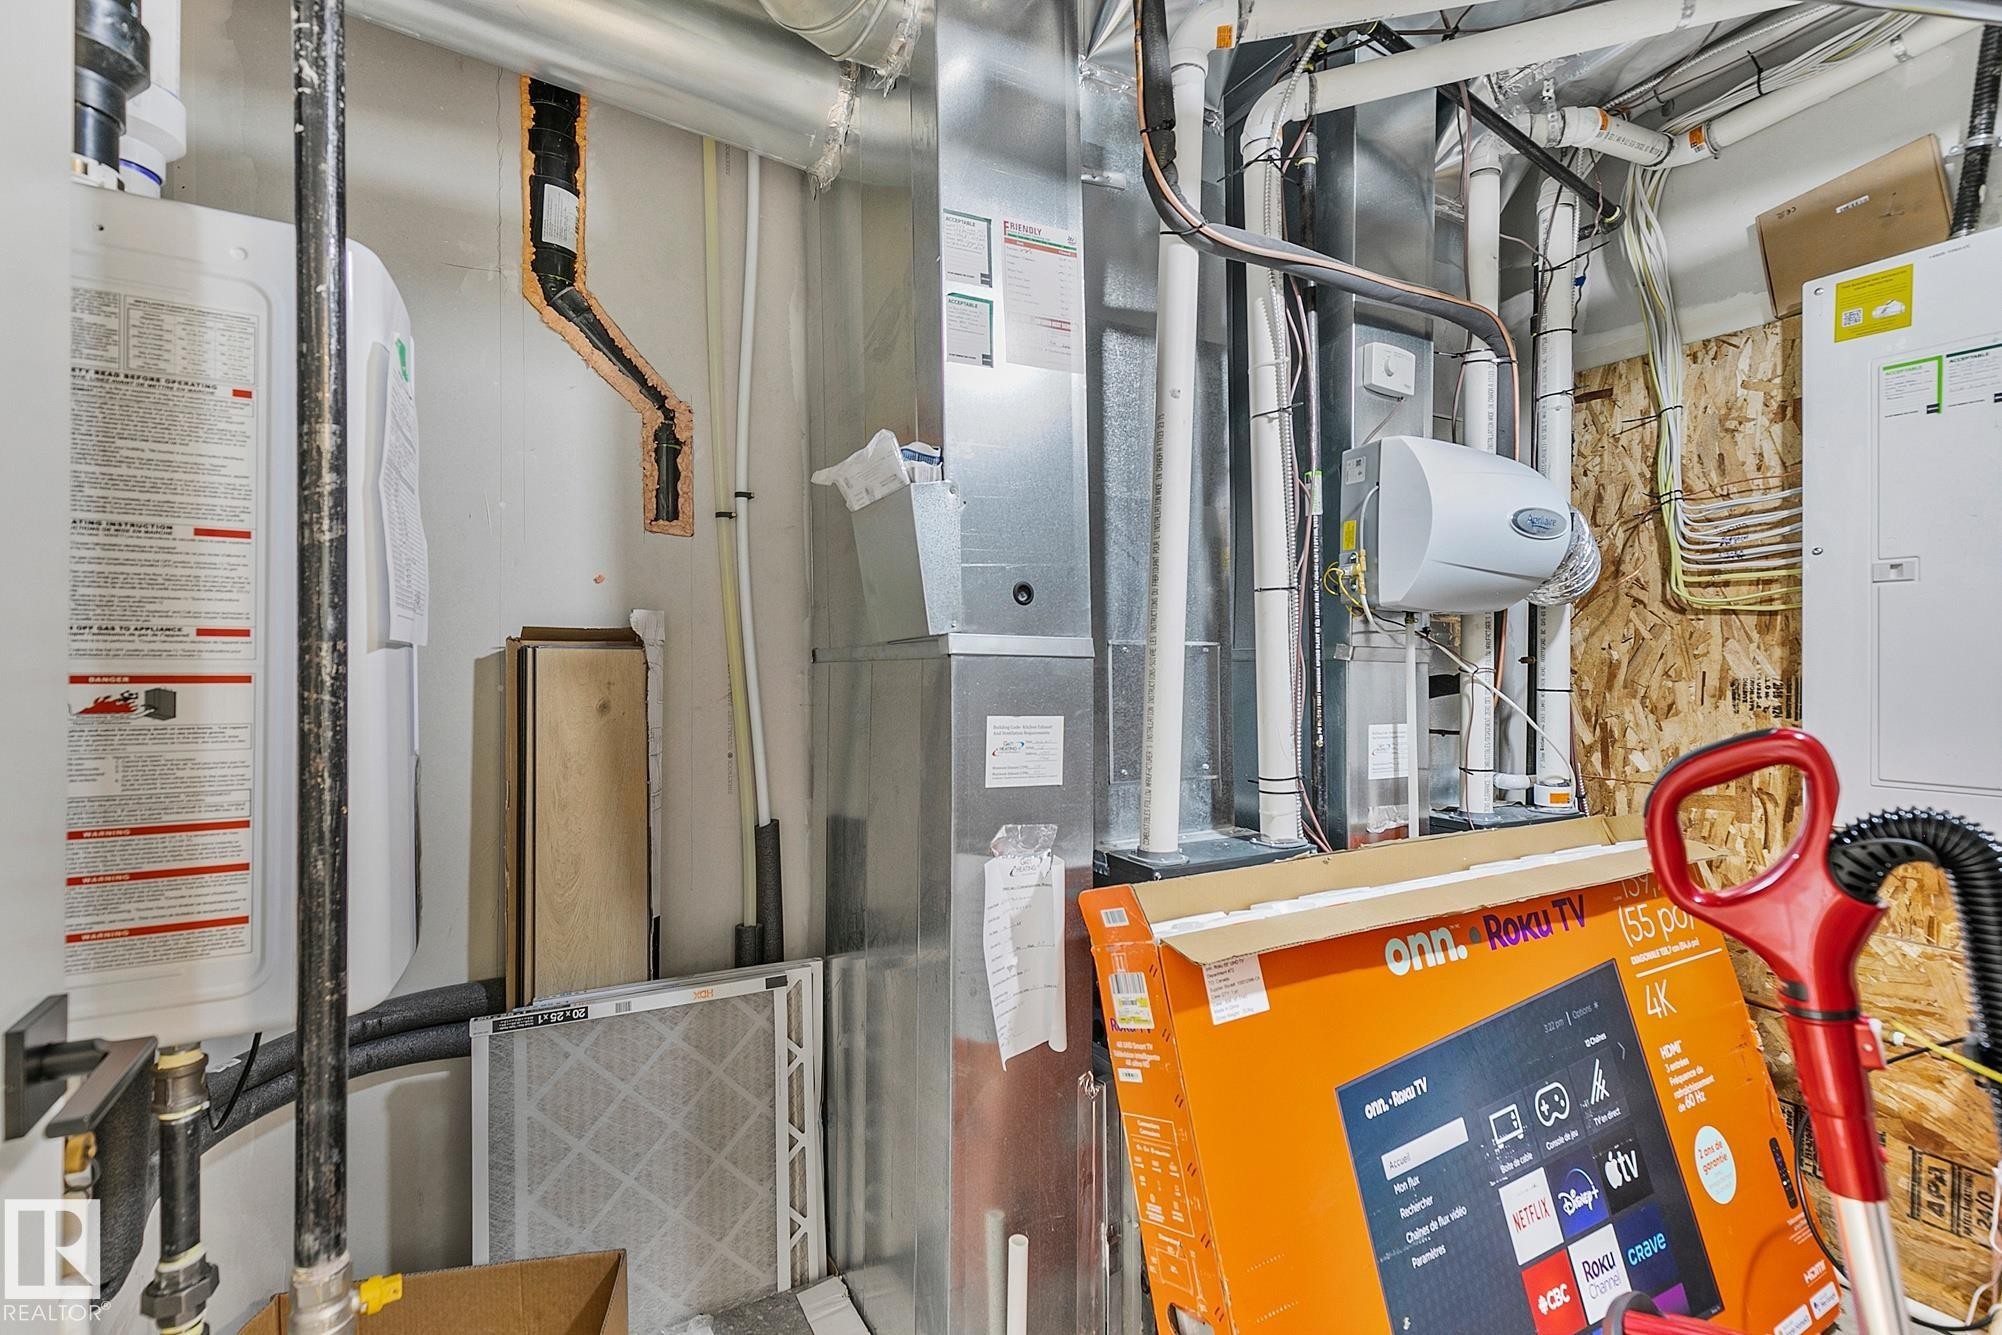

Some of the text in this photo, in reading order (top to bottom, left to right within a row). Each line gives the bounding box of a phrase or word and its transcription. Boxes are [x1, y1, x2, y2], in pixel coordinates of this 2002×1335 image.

[945, 216, 976, 227] ACCEPTABLE
[1003, 220, 1042, 236] FRIENDLY
[948, 298, 978, 309] ACCEPTABLE
[94, 370, 120, 379] READ
[123, 373, 161, 384] BEFORE
[164, 377, 218, 391] OPERATING
[106, 520, 173, 531] INSTRUCTION
[134, 626, 183, 634] APPLIANCE
[82, 829, 131, 839] WARNING
[81, 874, 131, 884] WARNING
[80, 929, 130, 941] WARNING
[1384, 894, 1585, 976] onn. Roku TV
[693, 988, 715, 1000] HDX
[1645, 979, 1677, 1019] 4K
[550, 1011, 564, 1022] 25
[572, 1008, 586, 1018] 20
[1571, 1005, 1592, 1020] Options
[1664, 1063, 1670, 1074] 3
[1696, 1064, 1704, 1075] de
[1391, 1085, 1417, 1108] Roku
[1413, 1076, 1428, 1096] TV
[1685, 1093, 1696, 1109] 60
[1694, 1089, 1707, 1104] Hz
[1593, 1116, 1602, 1127] TV
[1606, 1107, 1622, 1121] direct
[1545, 1129, 1579, 1151] Console de jeu
[1698, 1140, 1723, 1160] 2 ans de
[1513, 1158, 1521, 1168] de
[1702, 1153, 1729, 1176] garantie
[1393, 1176, 1421, 1195] Mon flux
[1399, 1195, 1434, 1219] Rechercher
[1512, 1198, 1551, 1233] NETFLIX
[1429, 1219, 1439, 1232] de
[1437, 1214, 1450, 1227] flux
[1449, 1205, 1468, 1221] vidéo
[1411, 1244, 1447, 1269] Paramètres
[1581, 1251, 1616, 1283] Roku
[1803, 1259, 1827, 1284] HDMI
[1589, 1270, 1622, 1300] Channel
[1546, 1283, 1571, 1311] CBC
